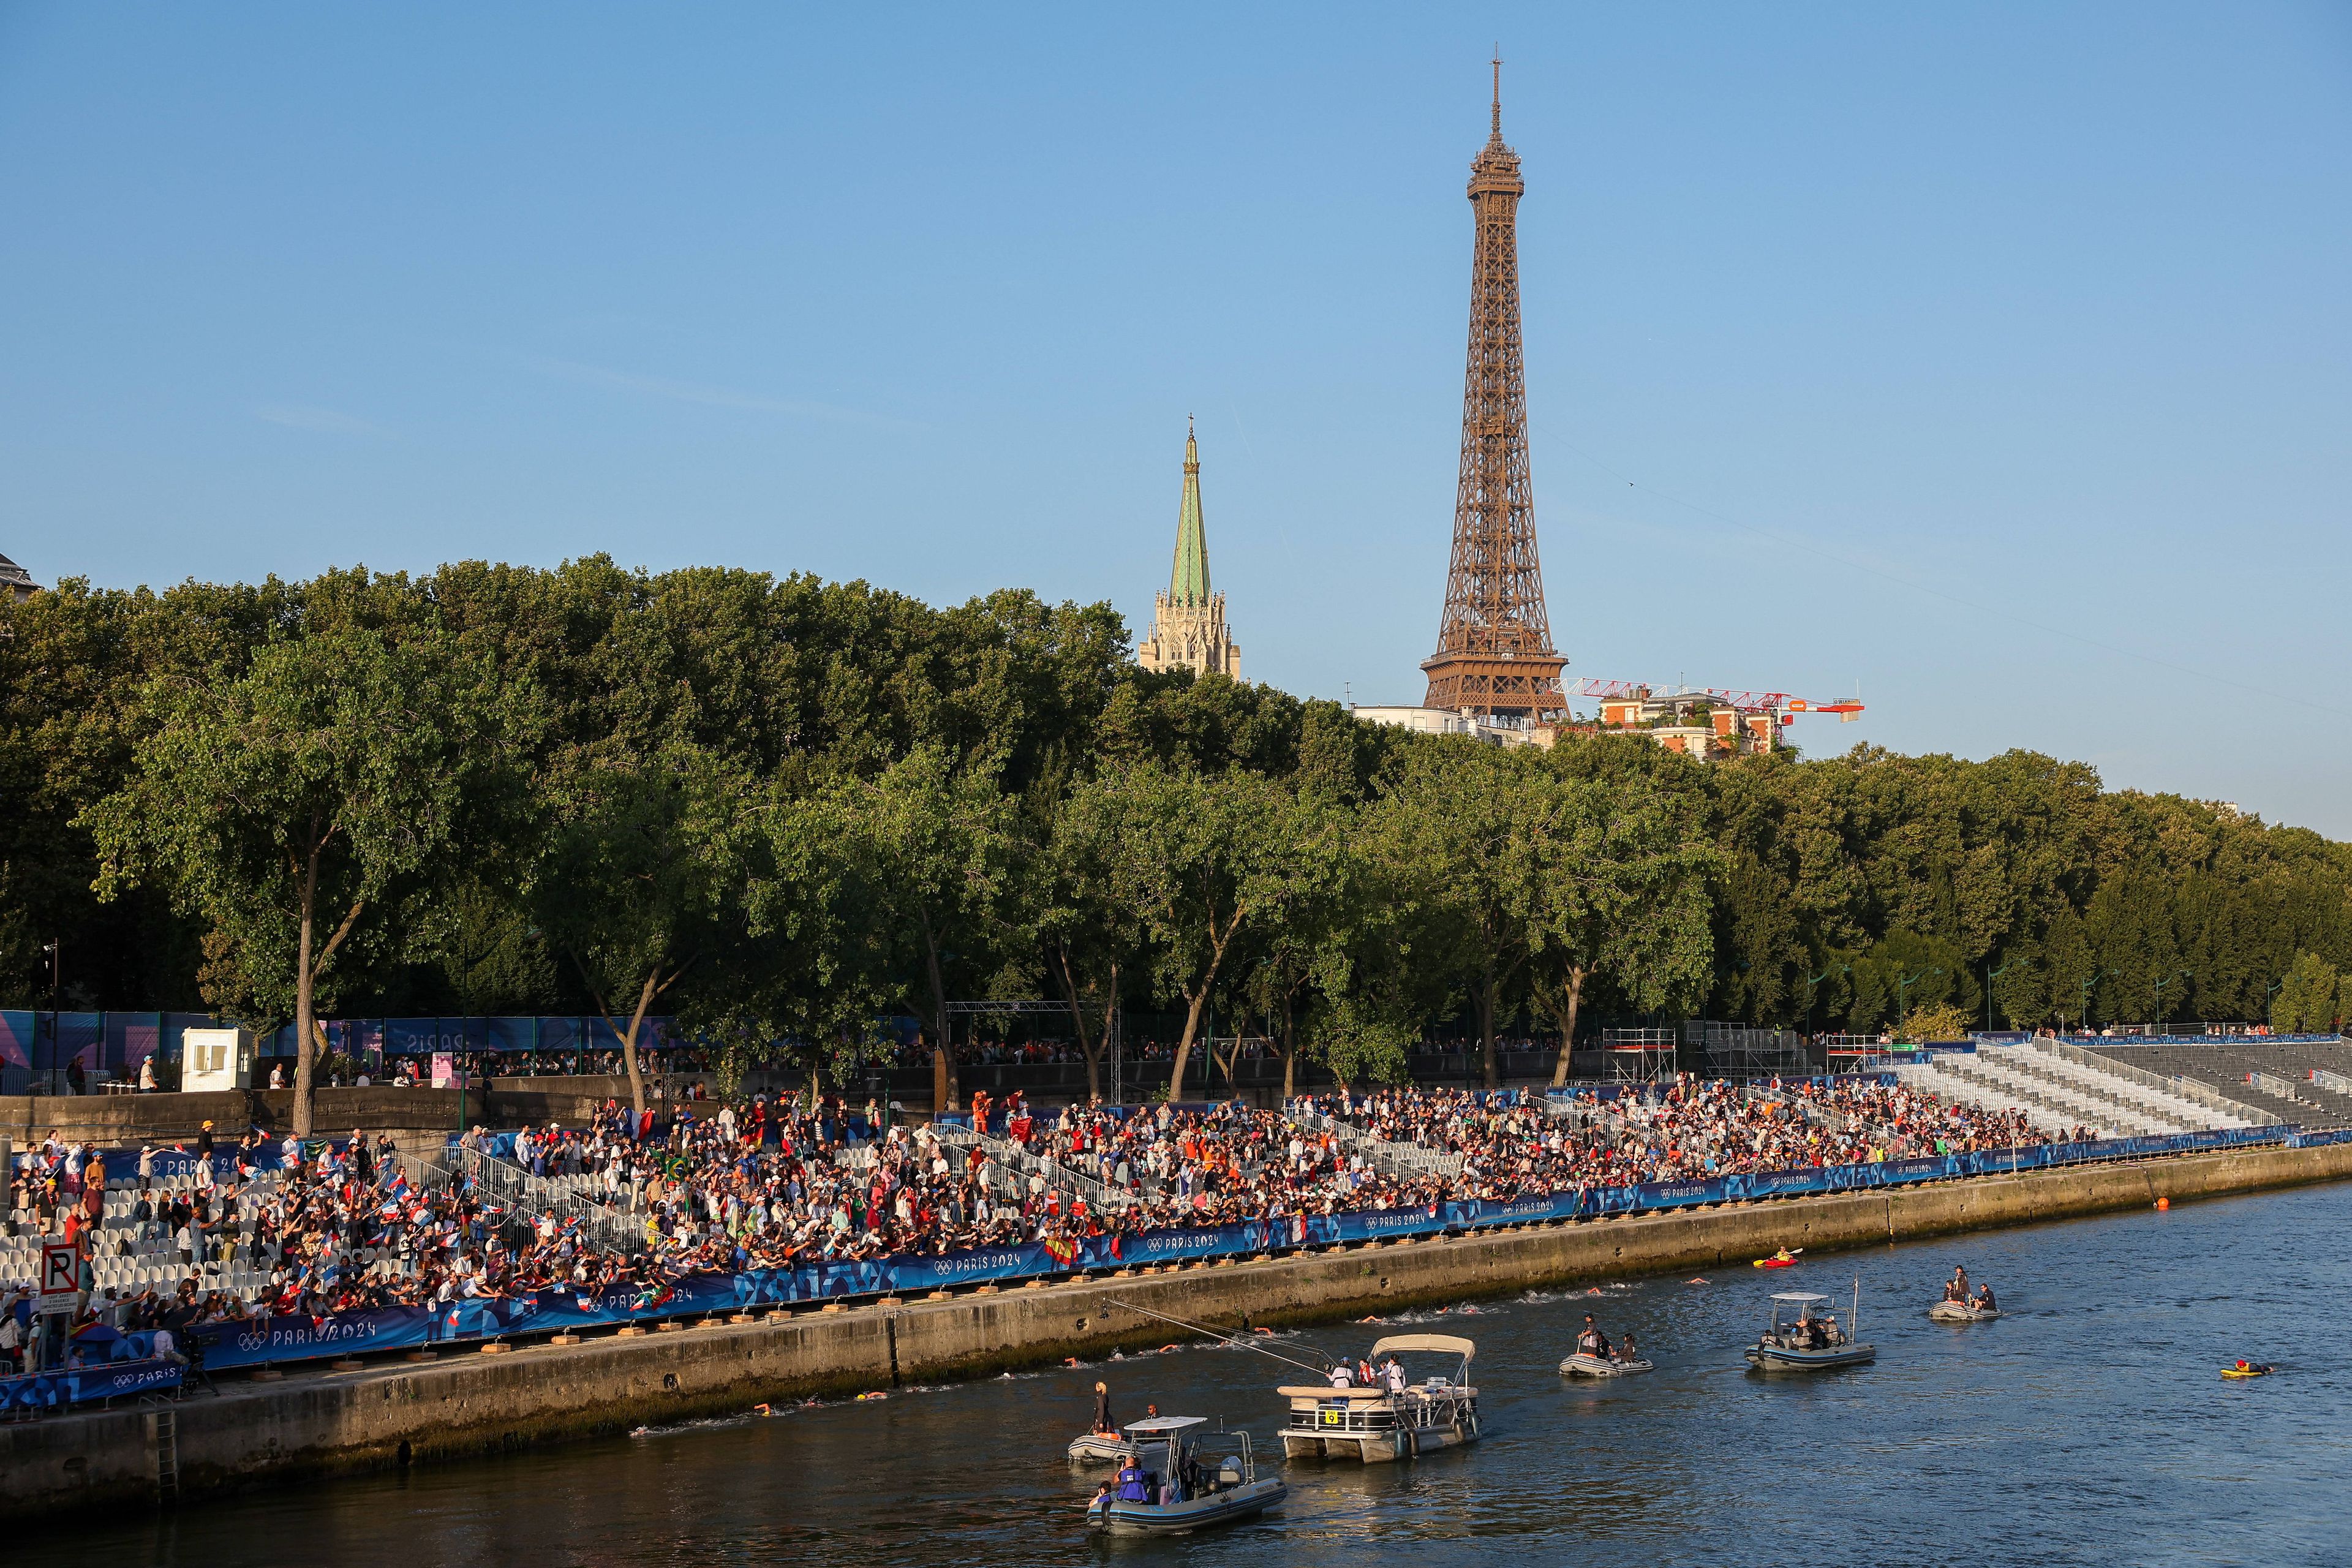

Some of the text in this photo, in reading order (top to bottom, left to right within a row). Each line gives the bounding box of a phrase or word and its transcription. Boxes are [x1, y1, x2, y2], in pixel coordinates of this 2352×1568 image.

[1919, 1164, 1931, 1173] 2024
[1796, 1175, 1809, 1184] 2024
[1691, 1186, 1705, 1196] 2024
[1536, 1200, 1554, 1211] 2024
[1404, 1213, 1425, 1225] 2024
[1195, 1234, 1218, 1247] 2024
[992, 1253, 1020, 1268] 2024
[50, 1253, 70, 1286] P
[331, 1321, 375, 1341] 2024
